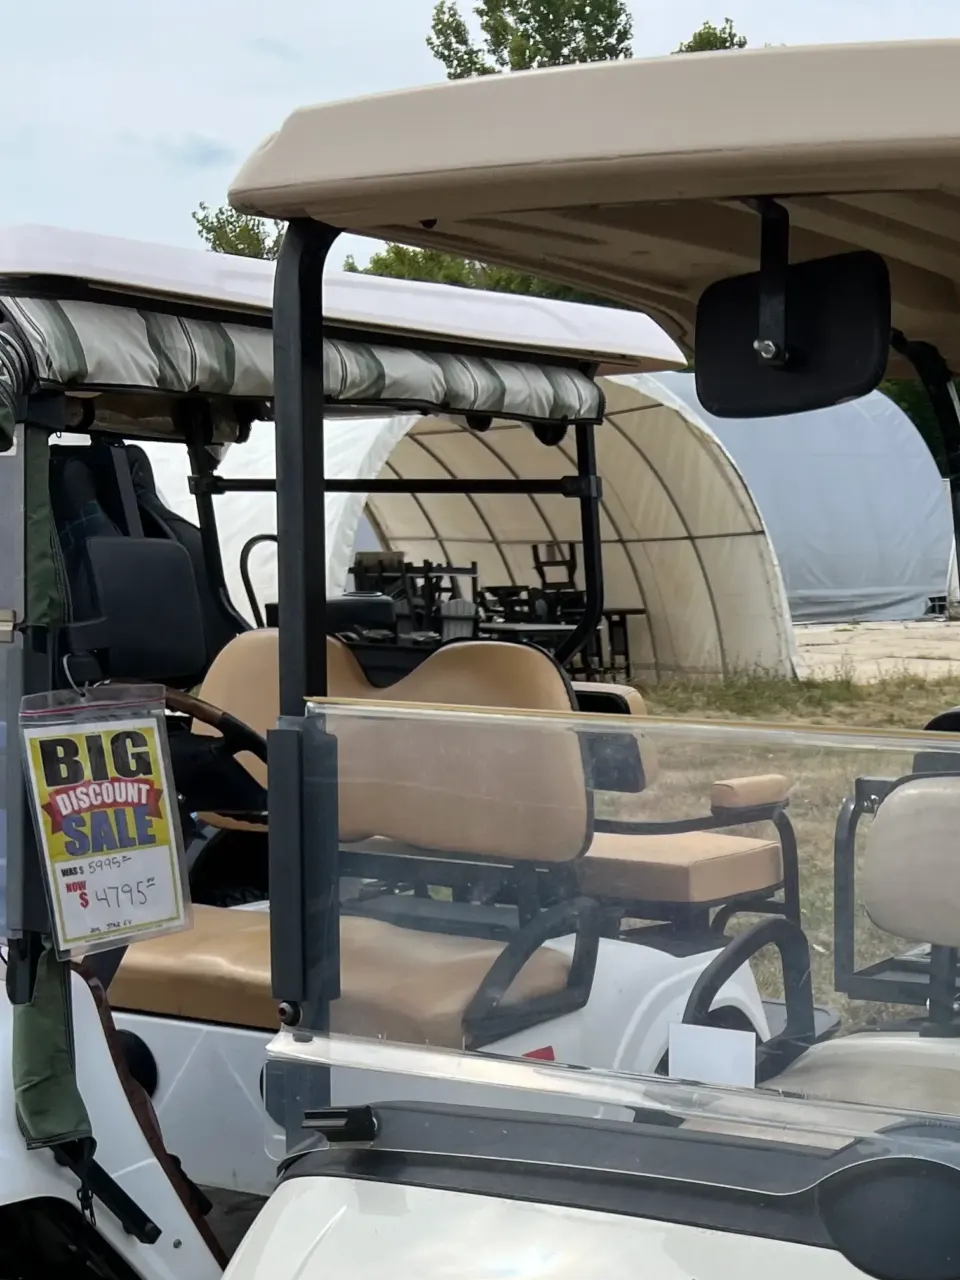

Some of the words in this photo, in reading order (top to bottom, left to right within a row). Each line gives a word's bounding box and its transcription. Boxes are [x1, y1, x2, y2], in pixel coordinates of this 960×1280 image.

[39, 731, 153, 787] BIG
[55, 782, 150, 816] DISCOUNT
[61, 806, 157, 857] SALE
[66, 880, 87, 893] NOW
[79, 891, 89, 909] $
